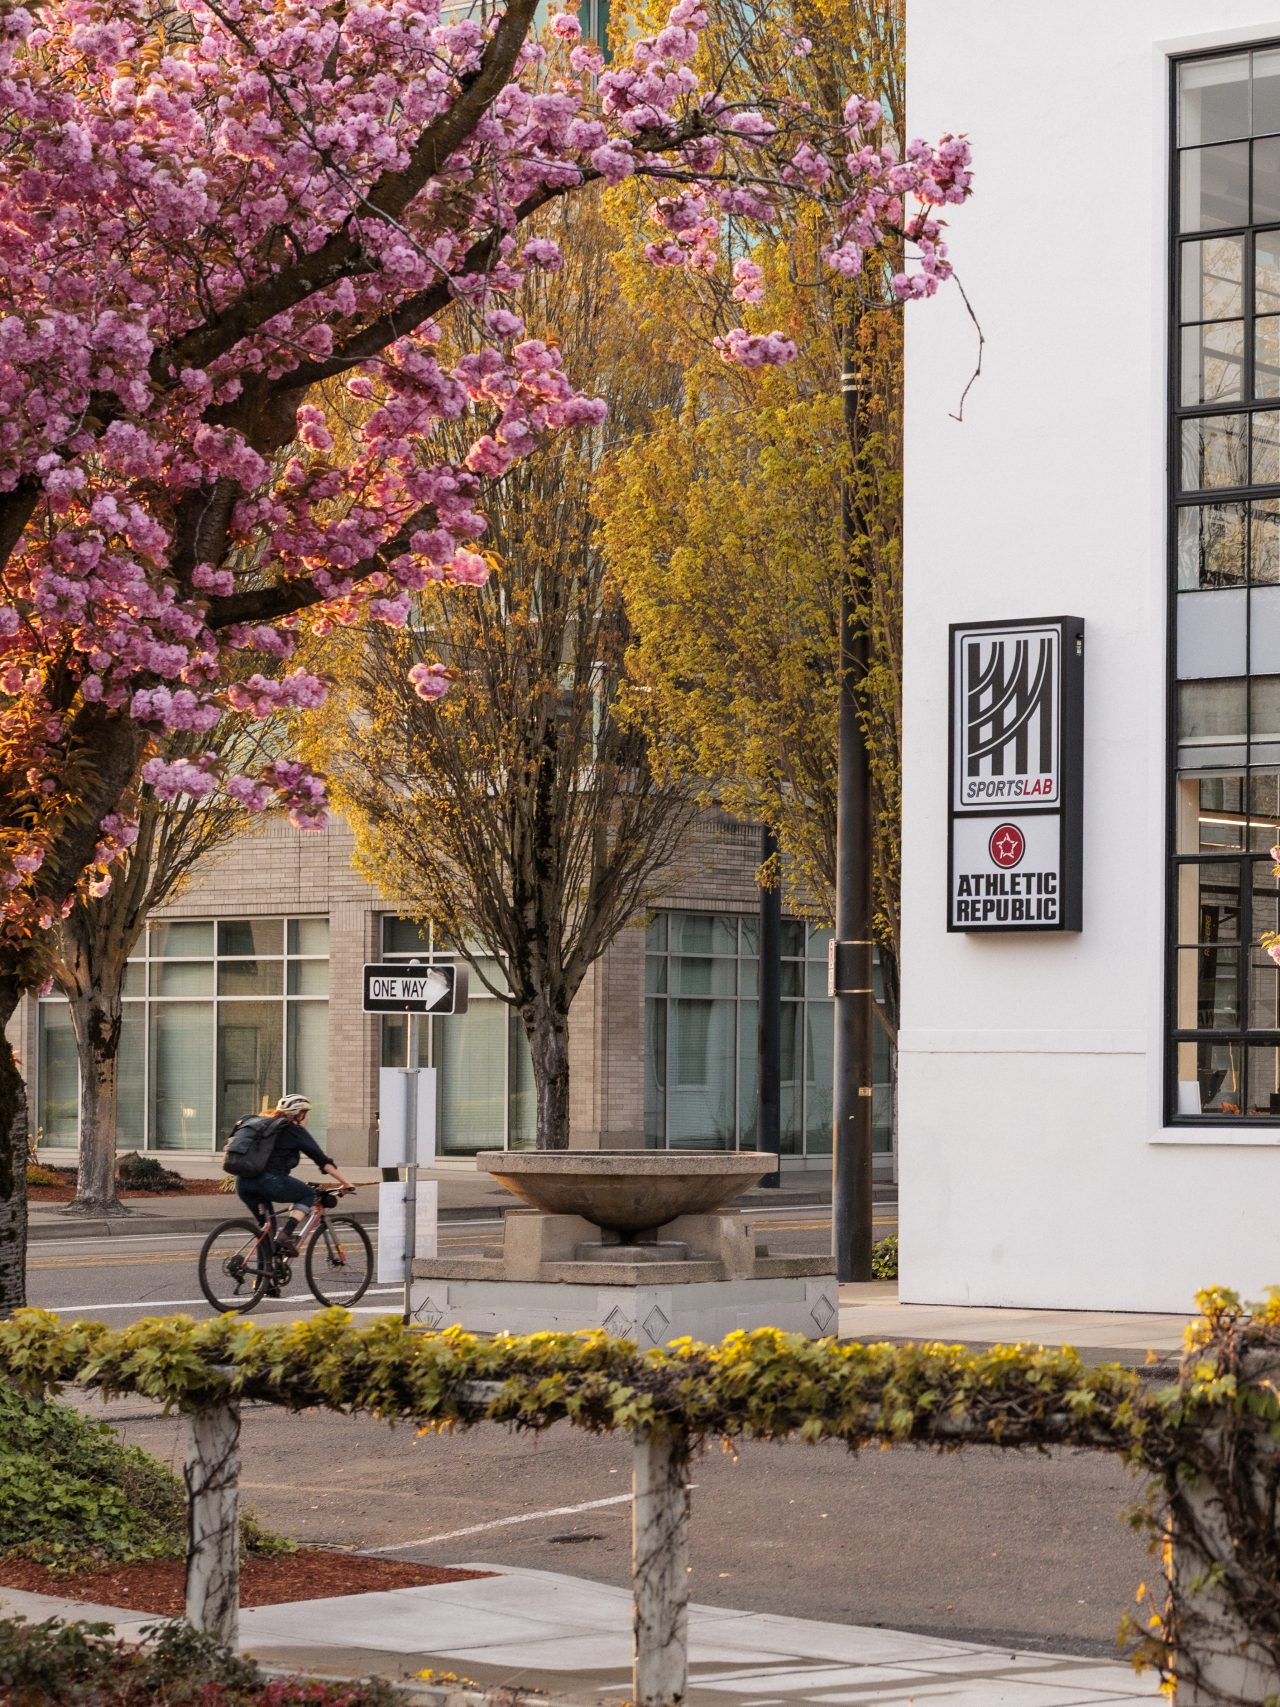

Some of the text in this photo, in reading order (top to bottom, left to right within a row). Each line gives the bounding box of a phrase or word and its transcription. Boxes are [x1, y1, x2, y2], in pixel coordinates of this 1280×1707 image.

[967, 778, 1053, 798] SPORTSLAB
[957, 872, 1057, 896] ATHLETIC
[956, 897, 1057, 922] REPUBLIC
[373, 979, 427, 998] ONE WAY
